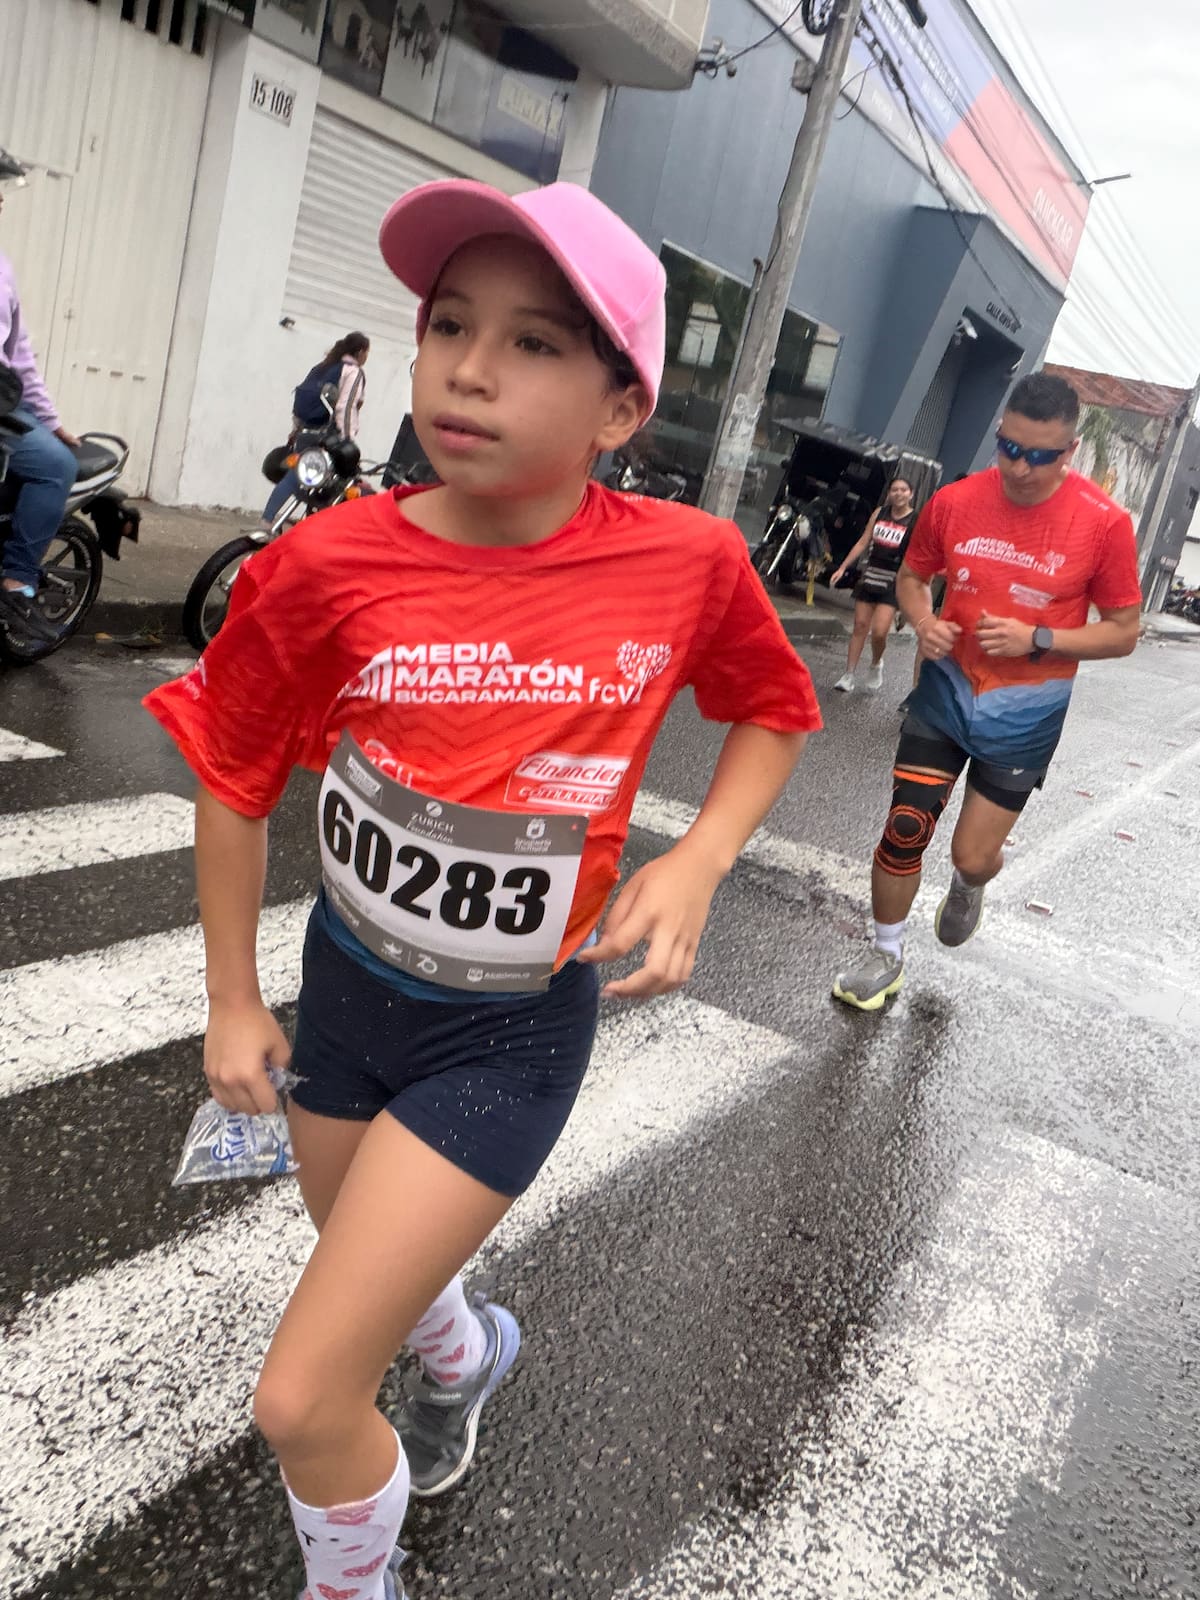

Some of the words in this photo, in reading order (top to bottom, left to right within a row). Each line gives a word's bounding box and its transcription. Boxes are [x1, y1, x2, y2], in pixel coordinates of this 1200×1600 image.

[394, 642, 513, 664] MEDIA
[394, 659, 584, 688] MARATÓN
[394, 688, 583, 704] BUCARAMANGA
[587, 678, 637, 705] fcv
[410, 811, 456, 833] ZURICH
[322, 789, 551, 935] 60283
